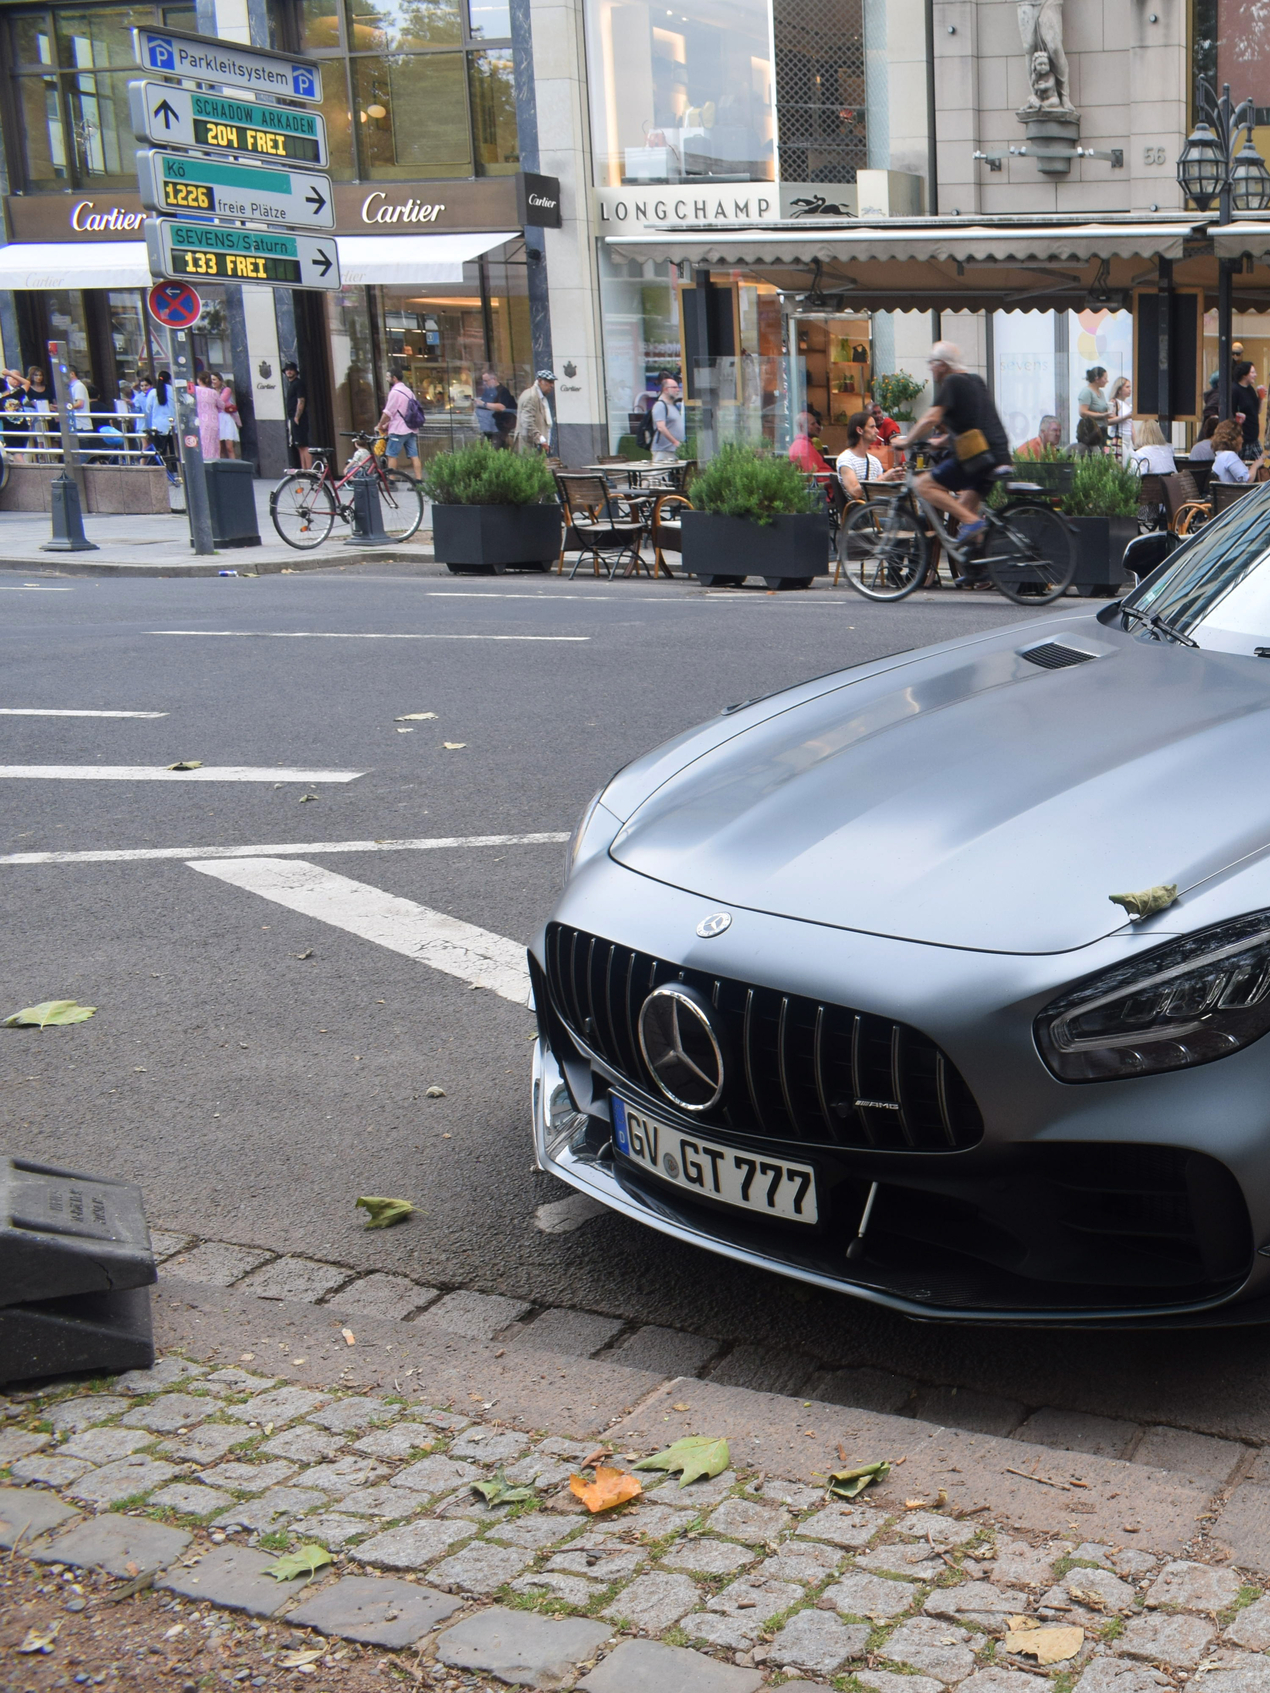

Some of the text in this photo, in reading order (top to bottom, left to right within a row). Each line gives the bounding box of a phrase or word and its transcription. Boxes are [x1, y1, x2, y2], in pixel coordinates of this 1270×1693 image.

[179, 49, 288, 86] Parkleitsystem
[195, 99, 314, 134] SCHADOW ARKADEN
[206, 124, 287, 156] 204 FREI
[166, 160, 186, 177] Kö
[1143, 146, 1166, 166] 56
[165, 183, 287, 219] 1226 freie Plätze
[361, 191, 445, 224] Cartier
[528, 193, 557, 209] Cartier
[600, 198, 770, 222] LONGCHAMP
[72, 201, 147, 232] Cartier
[175, 229, 288, 254] SEVENS/Saturn
[185, 251, 267, 278] 133 FREI
[25, 271, 65, 288] Cartier
[868, 1101, 899, 1110] AMG
[618, 1129, 626, 1144] D
[626, 1110, 811, 1215] GV GT 777
